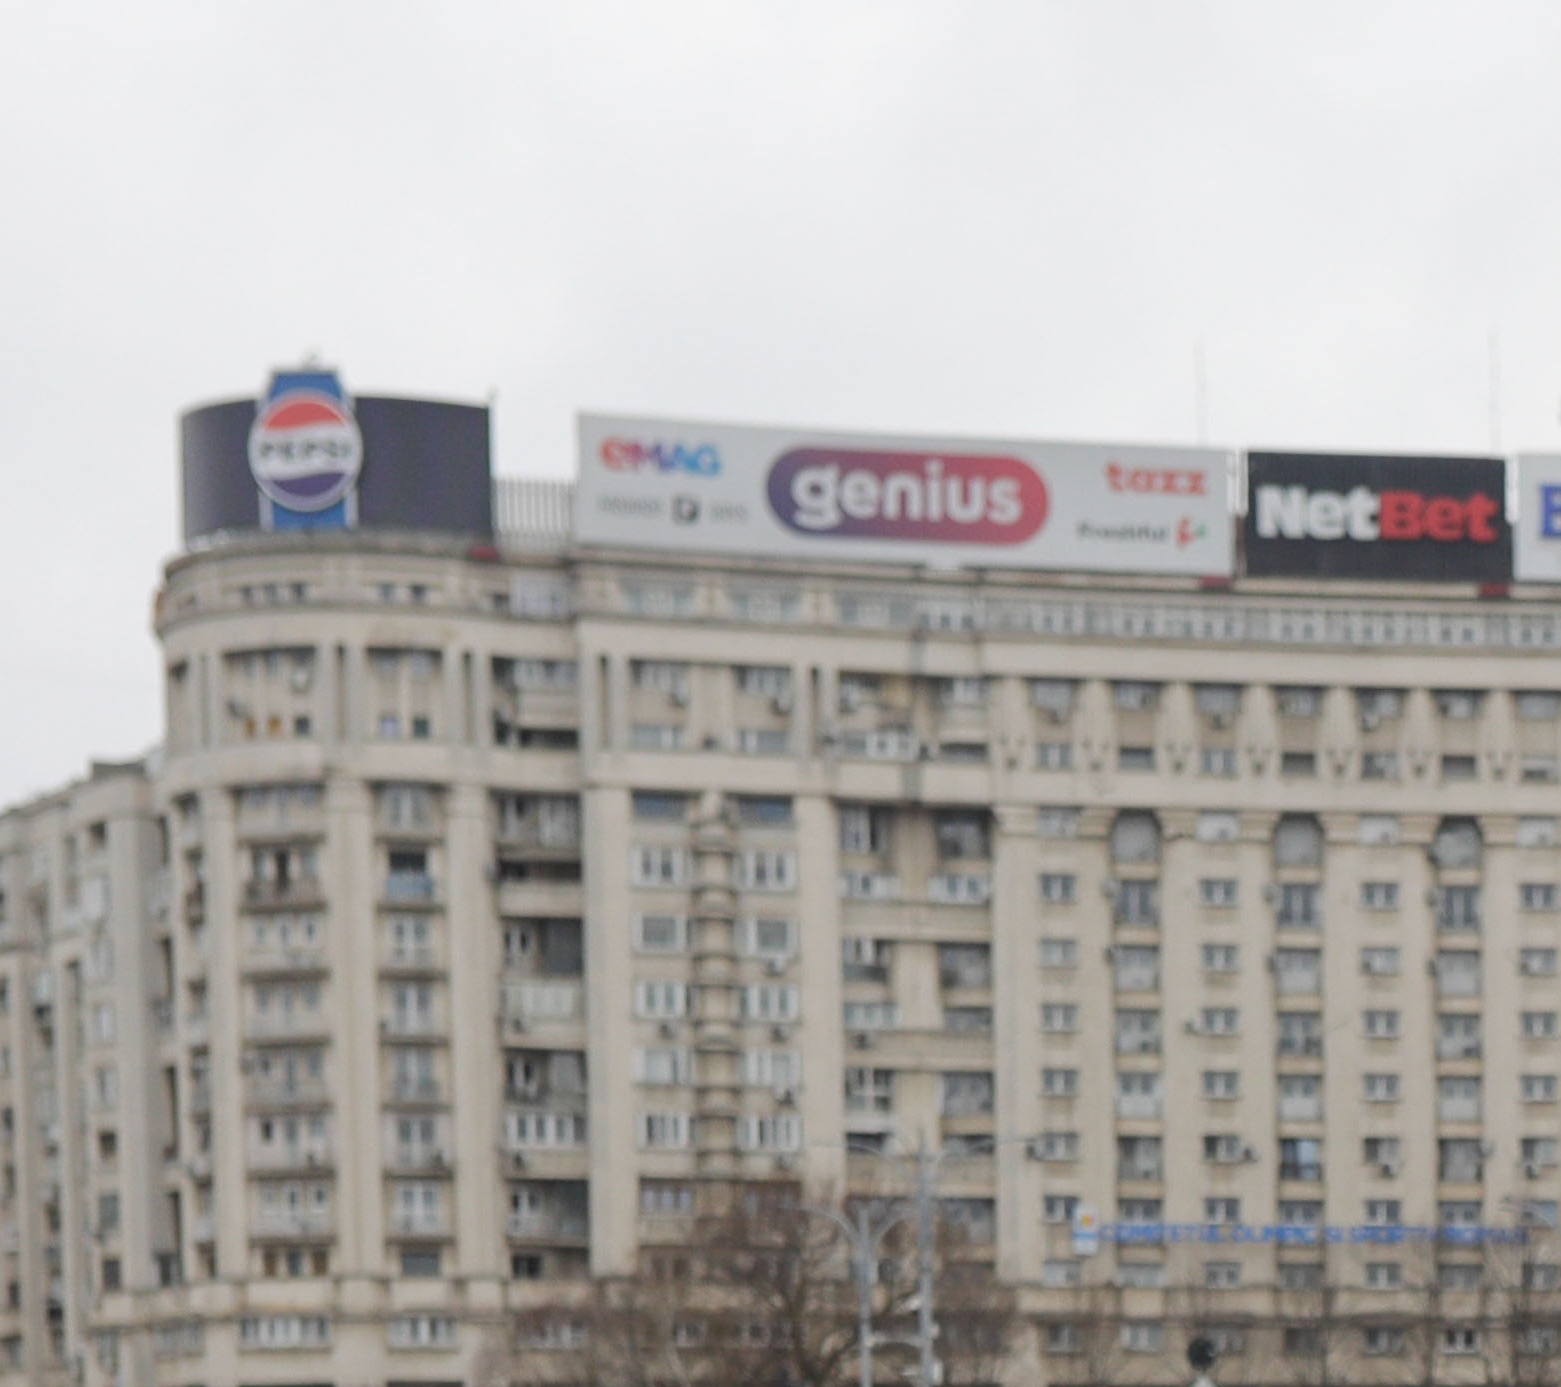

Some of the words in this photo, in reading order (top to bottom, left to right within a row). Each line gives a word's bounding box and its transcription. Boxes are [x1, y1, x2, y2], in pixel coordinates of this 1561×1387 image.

[790, 456, 1025, 531] genius
[1105, 461, 1208, 497] tazz
[1255, 483, 1499, 543] NetBet
